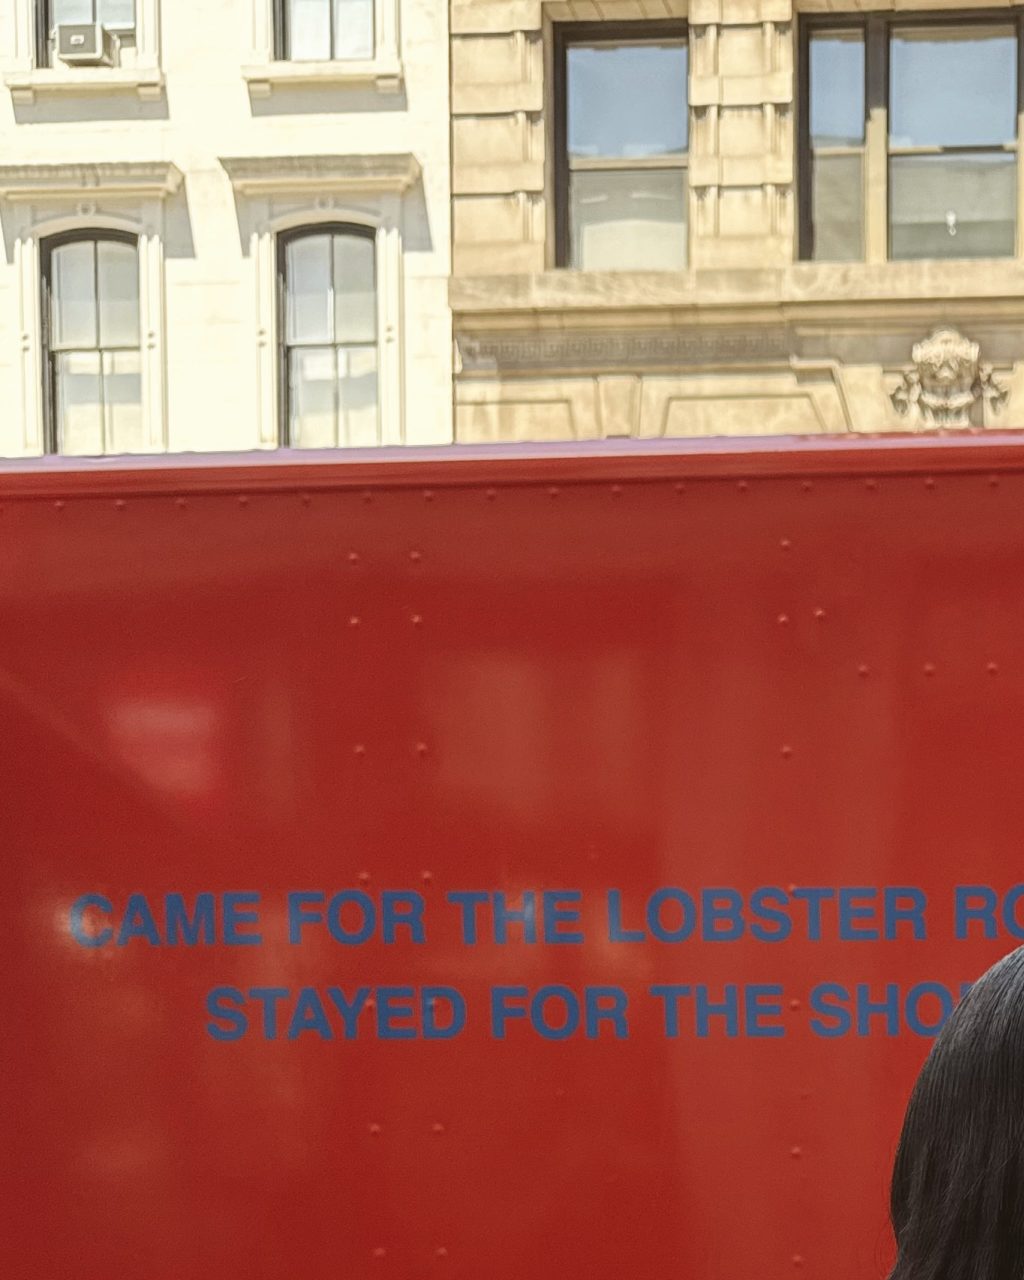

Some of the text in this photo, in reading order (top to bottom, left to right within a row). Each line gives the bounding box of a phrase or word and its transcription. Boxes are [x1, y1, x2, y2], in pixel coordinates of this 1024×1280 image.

[70, 892, 262, 949] CAME
[288, 890, 426, 945] FOR
[448, 891, 584, 945] THE
[608, 887, 927, 943] LOBSTER
[206, 981, 977, 1041] STAYED FOR THE SHO
